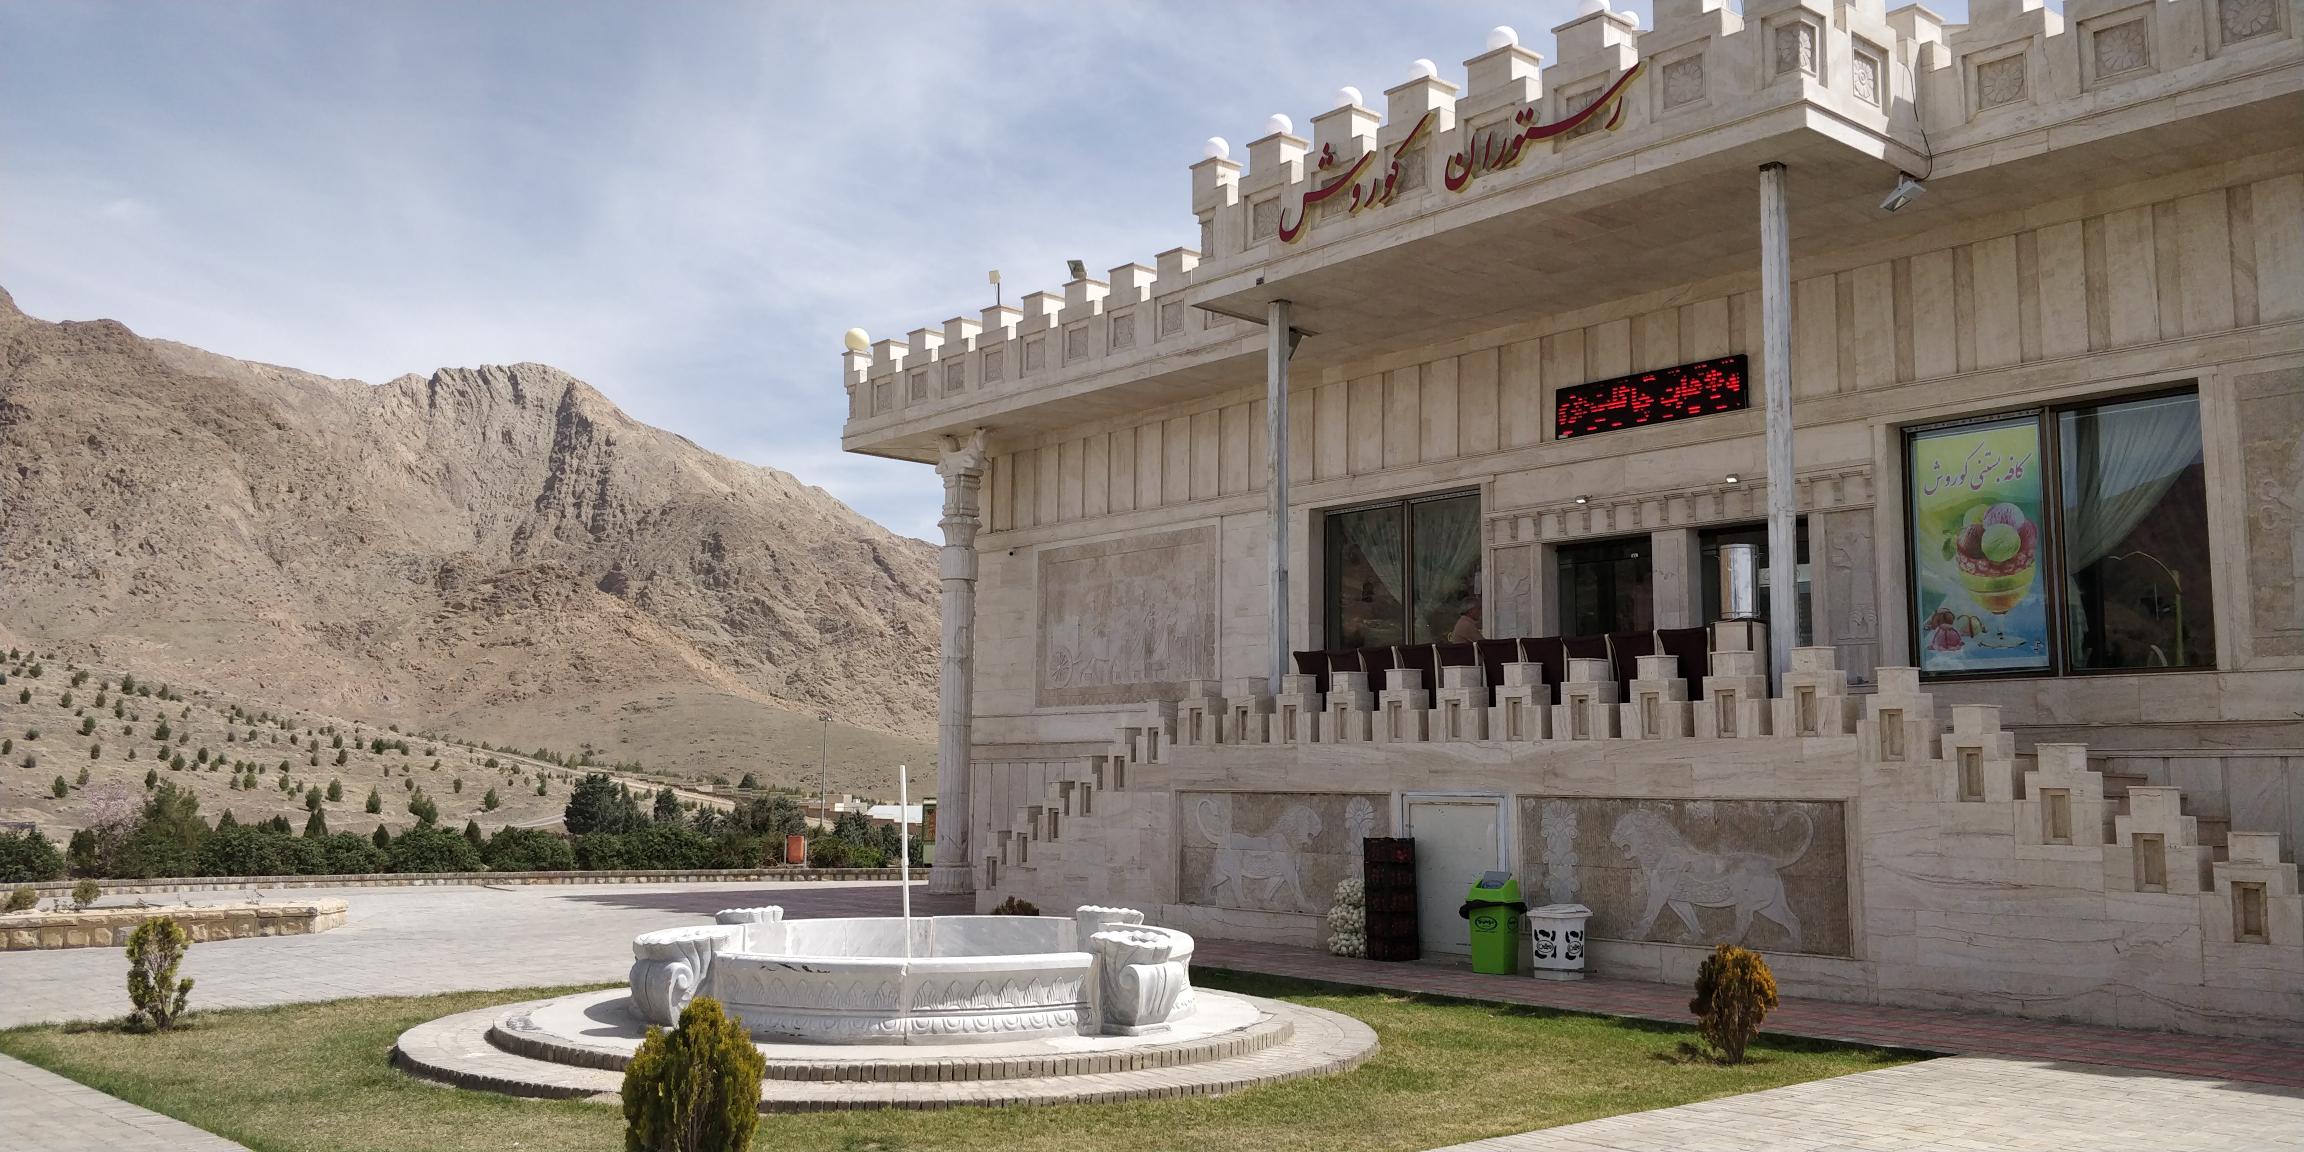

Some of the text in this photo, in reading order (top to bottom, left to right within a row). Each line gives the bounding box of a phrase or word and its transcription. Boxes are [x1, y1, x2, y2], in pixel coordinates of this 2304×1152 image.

[1278, 61, 1647, 244] رستوران کوروش
[1923, 440, 2032, 496] کافه بستنی کوروش
